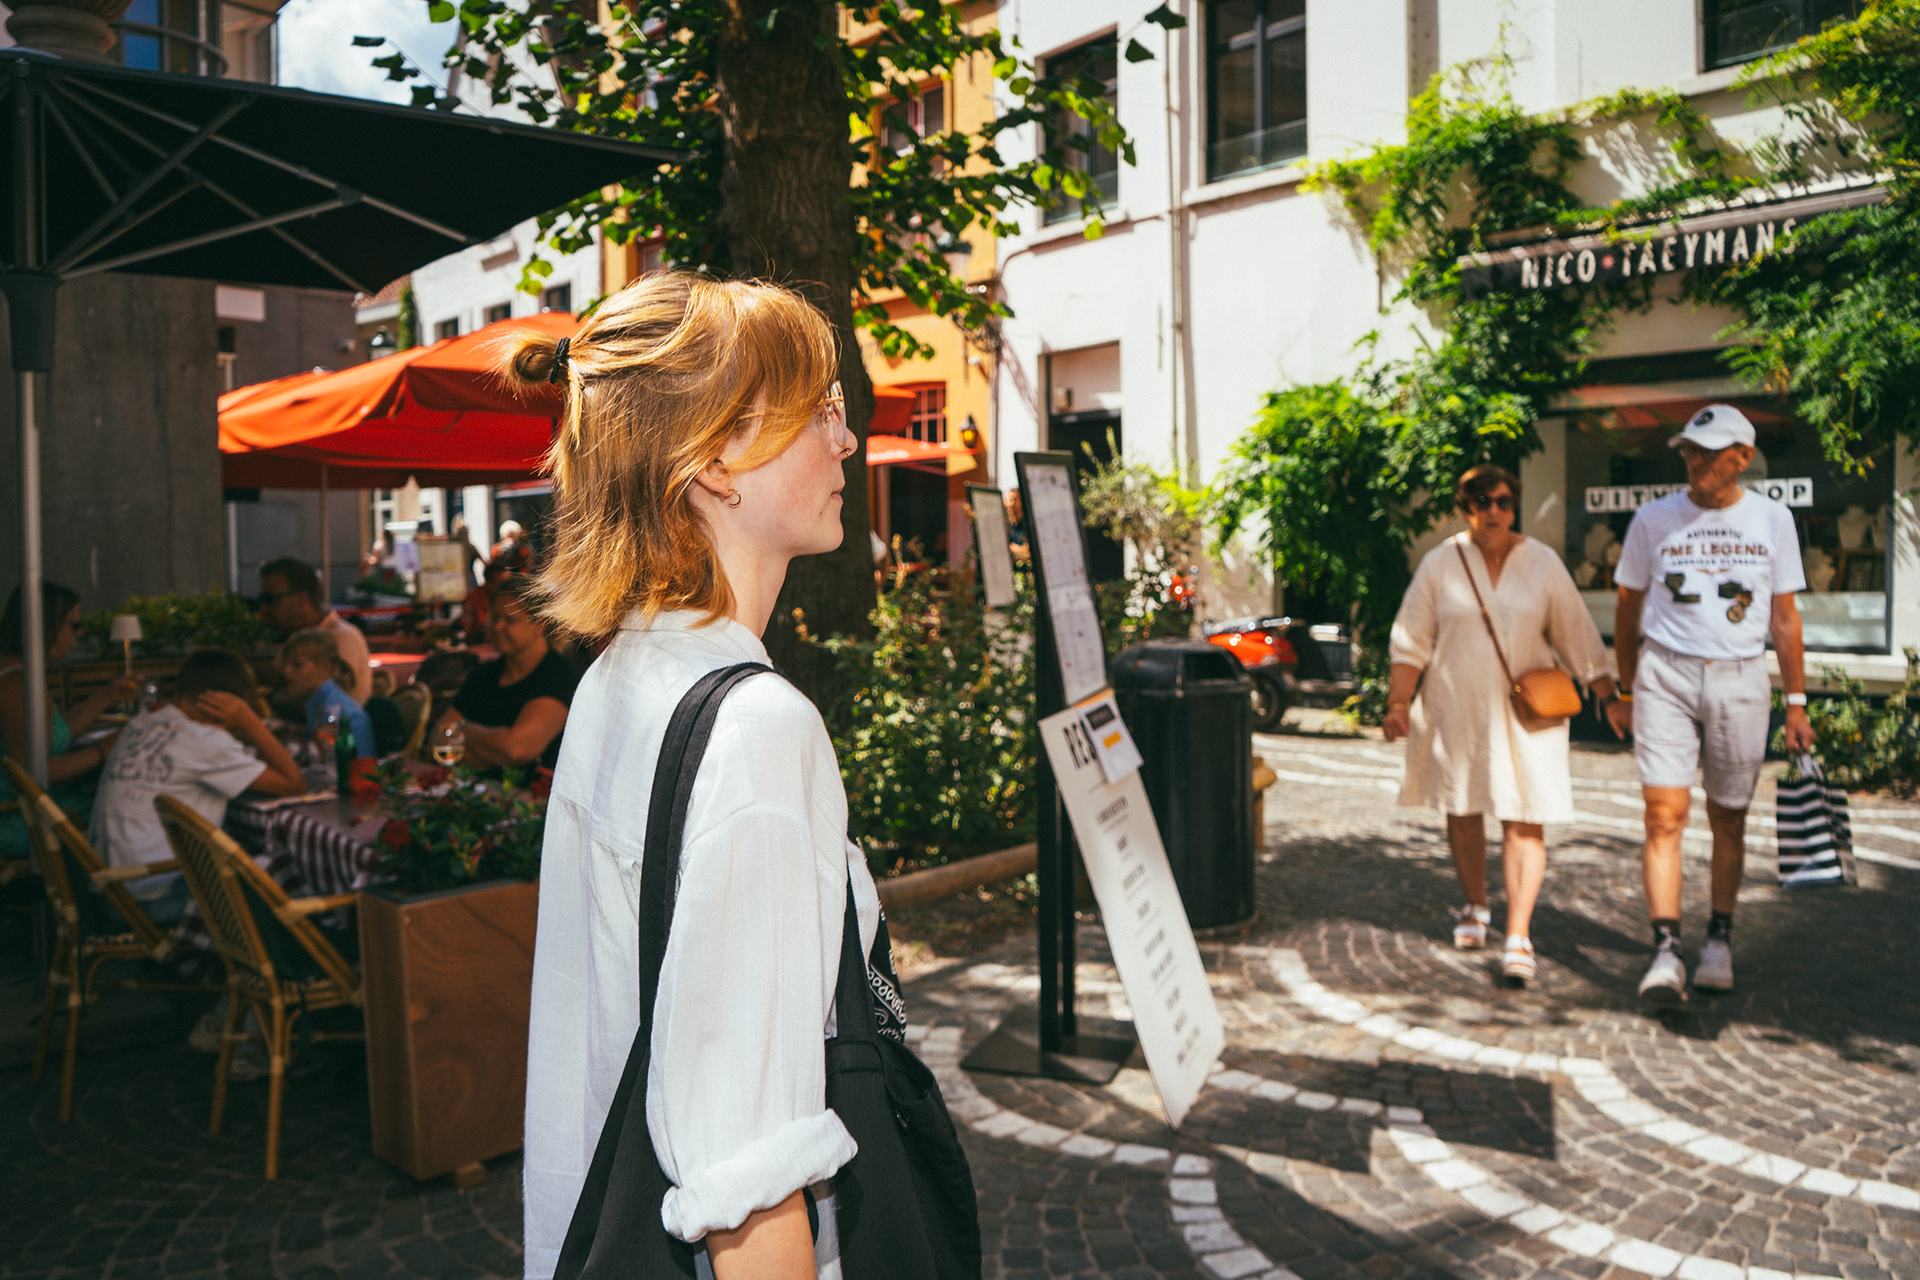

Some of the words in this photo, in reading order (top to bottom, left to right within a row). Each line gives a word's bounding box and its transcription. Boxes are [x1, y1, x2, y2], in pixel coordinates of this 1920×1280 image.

[1521, 249, 1596, 289] NICO
[1621, 217, 1797, 277] TAEYMANS
[1701, 542, 1768, 556] LEGEND
